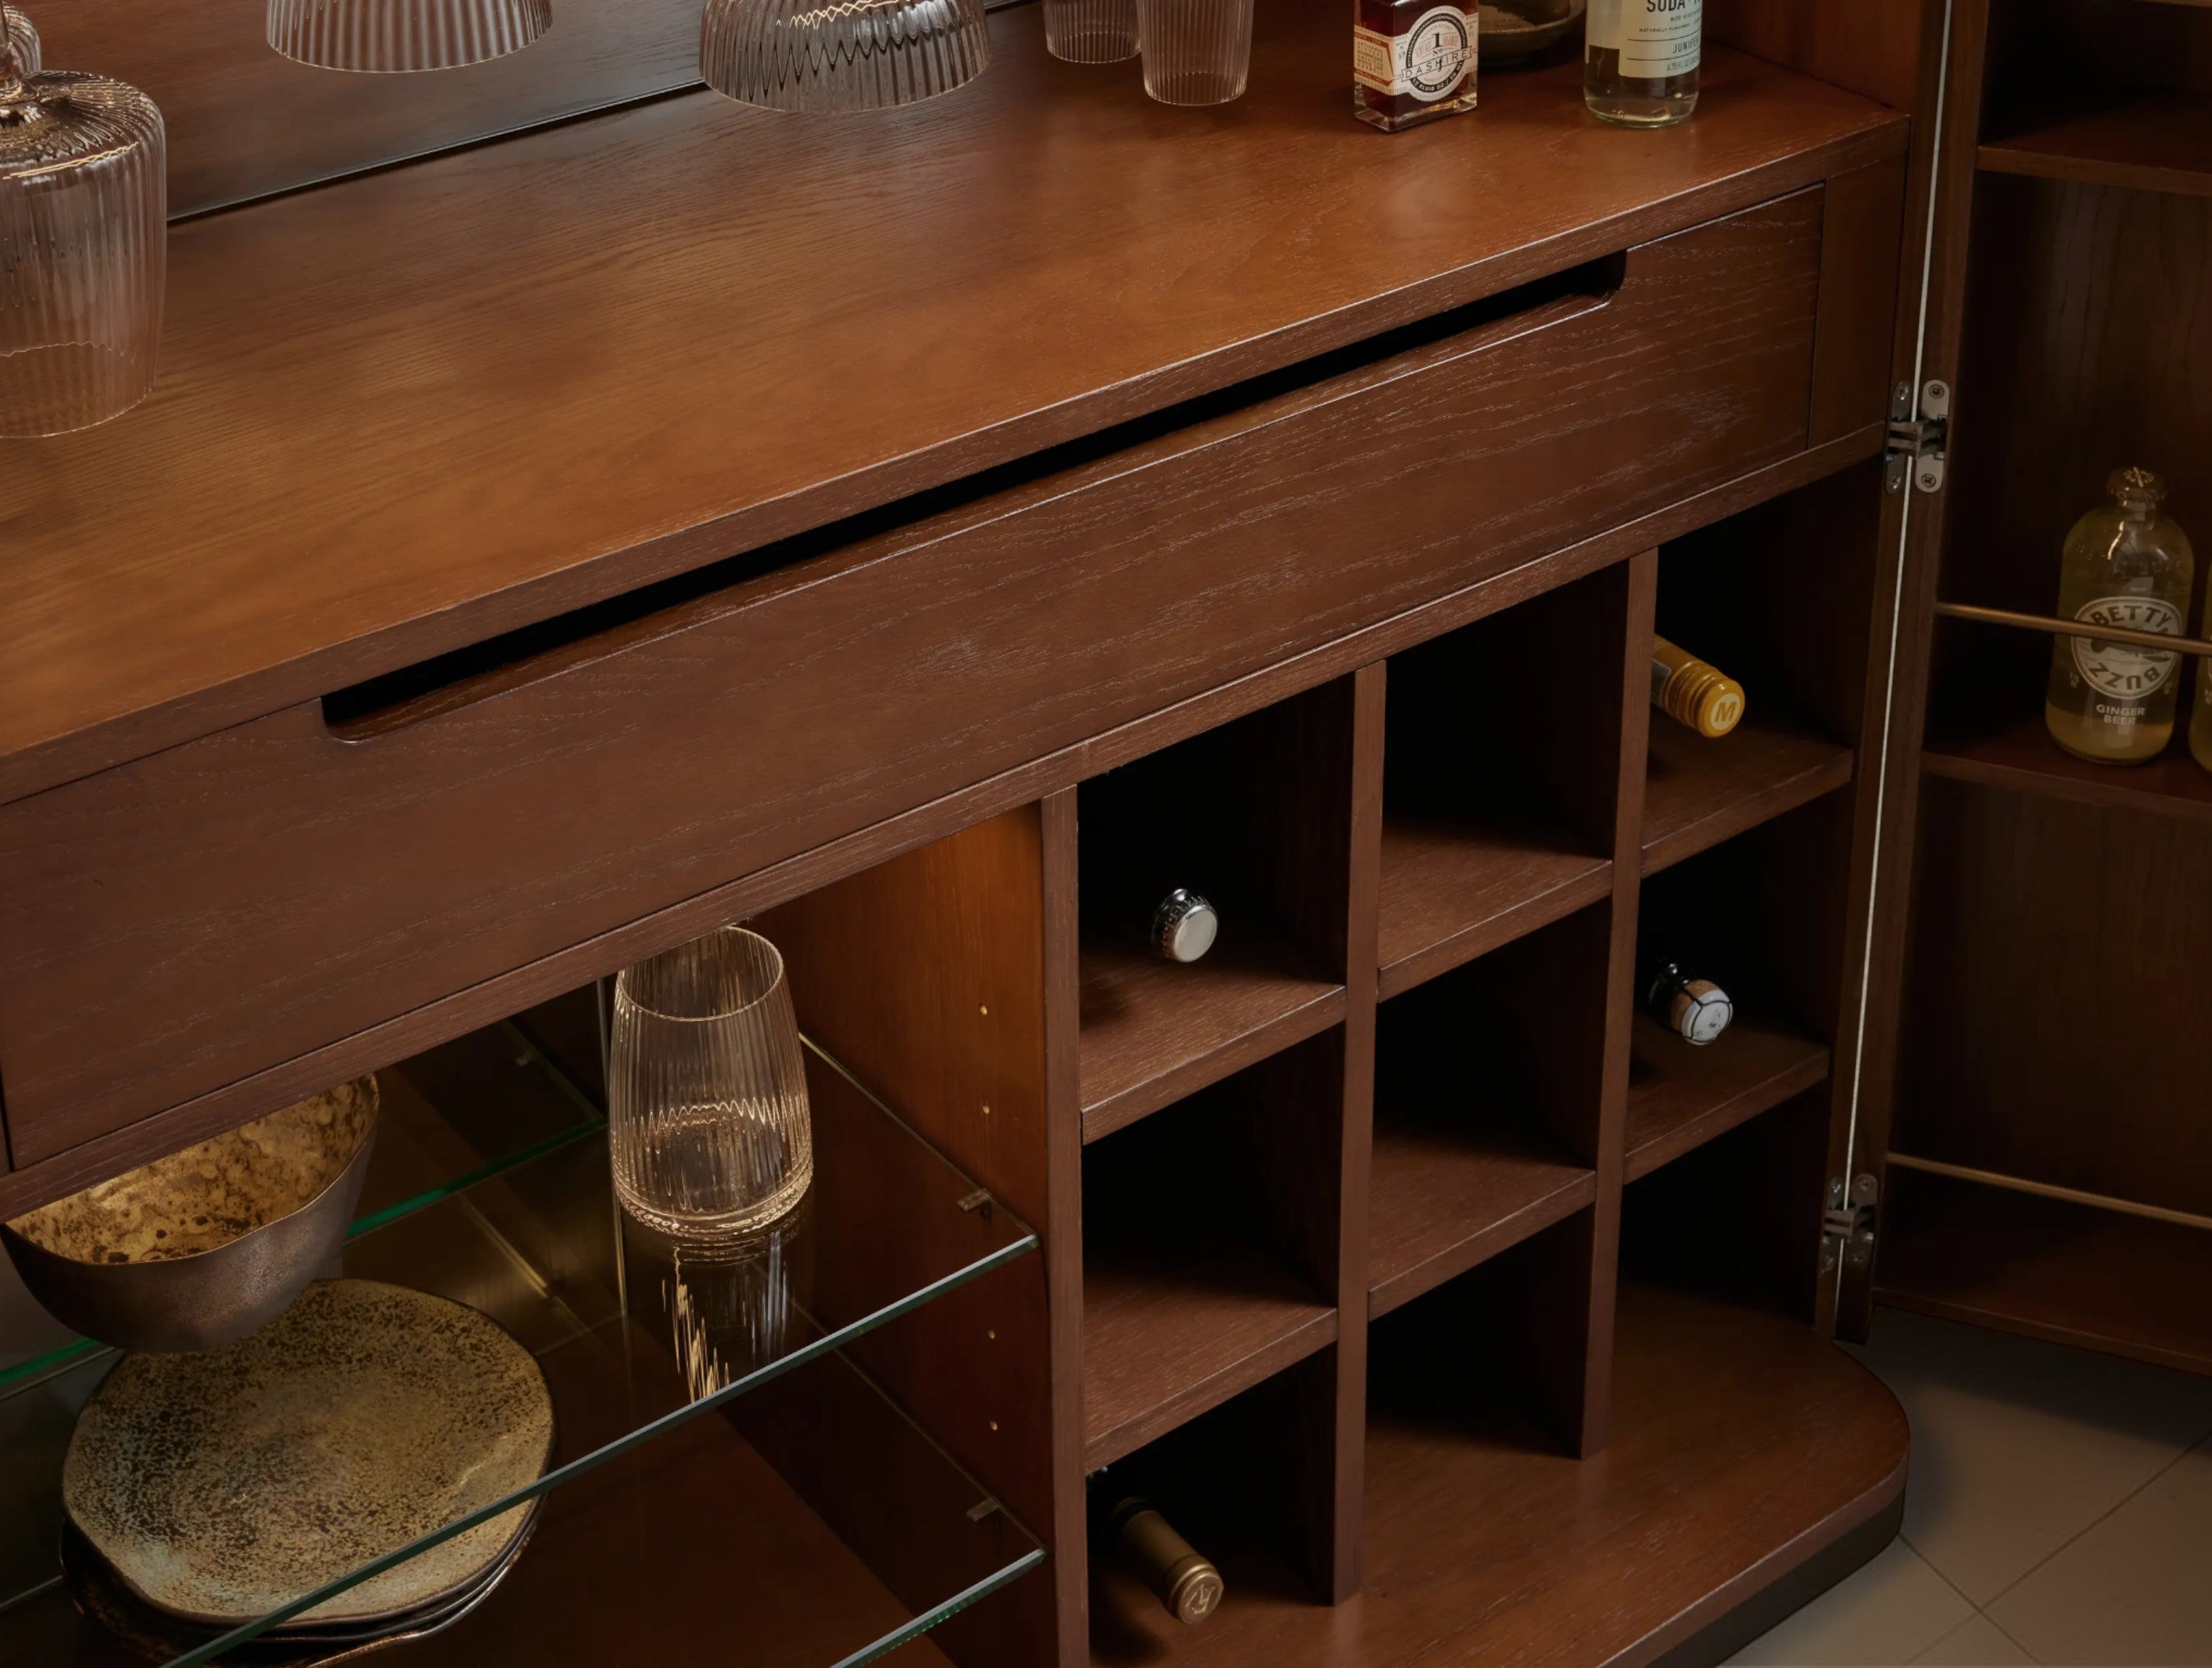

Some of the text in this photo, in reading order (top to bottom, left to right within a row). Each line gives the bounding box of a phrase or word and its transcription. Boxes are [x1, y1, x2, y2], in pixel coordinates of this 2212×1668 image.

[1647, 0, 1685, 12] SODA
[1672, 36, 1699, 54] JUNIPER
[2089, 605, 2173, 628] BETTY
[2089, 661, 2161, 690] BUZZ
[1714, 701, 1738, 722] M
[2096, 703, 2146, 716] GINGER
[2103, 714, 2137, 725] BEER
